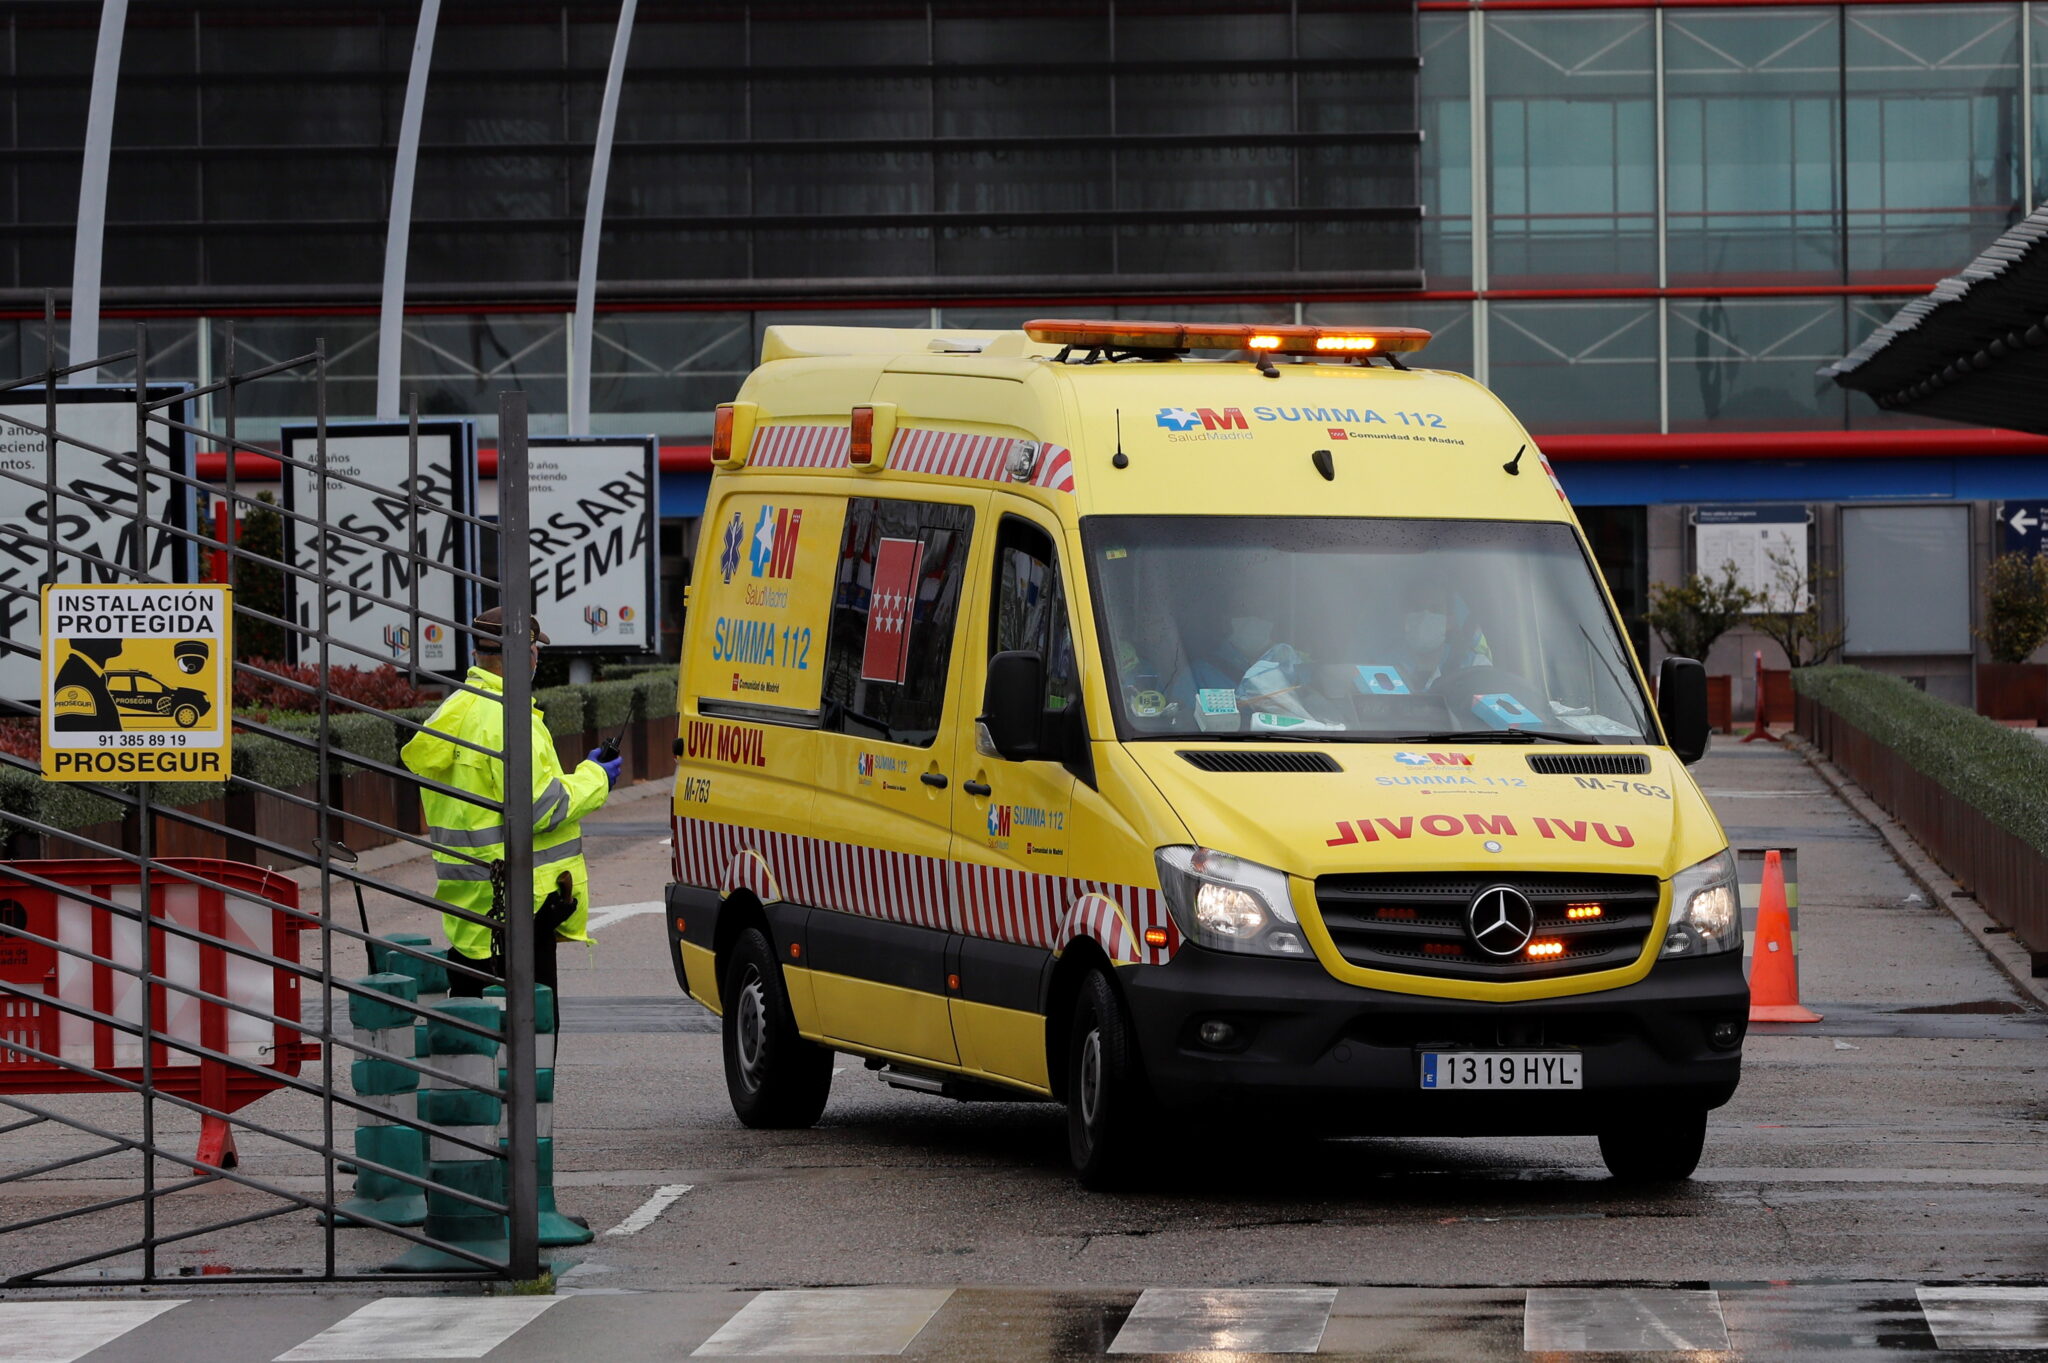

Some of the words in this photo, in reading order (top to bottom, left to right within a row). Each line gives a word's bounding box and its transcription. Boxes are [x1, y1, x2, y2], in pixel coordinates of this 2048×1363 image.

[1253, 406, 1387, 424] SUMMA
[1394, 411, 1447, 428] 112
[1167, 432, 1253, 443] SaludMadrid
[1349, 431, 1409, 441] Comunidad
[1429, 436, 1464, 446] Madrid
[0, 460, 35, 470] ntos.
[58, 591, 213, 612] INSTALACIÓN
[57, 615, 214, 633] PROTEGIDA
[713, 616, 775, 666] SUMMA
[782, 625, 811, 670] 112
[55, 700, 92, 708] PROSEGUR
[116, 697, 153, 705] PROSEGUR
[99, 735, 114, 746] 91
[119, 735, 144, 746] 385
[149, 735, 165, 746] 89
[170, 735, 186, 746] 19
[688, 721, 713, 758] UVI
[717, 724, 766, 767] MOVIL
[55, 752, 219, 772] PROSEGUR
[684, 777, 711, 803] M-763
[1375, 775, 1477, 786] SUMMA
[1483, 777, 1528, 787] 112
[1573, 777, 1672, 800] M-763
[1013, 805, 1046, 827] SUMMA
[1049, 810, 1064, 830] 112
[1427, 1074, 1433, 1082] E
[1448, 1058, 1514, 1084] 1319
[1524, 1058, 1574, 1084] HYL
